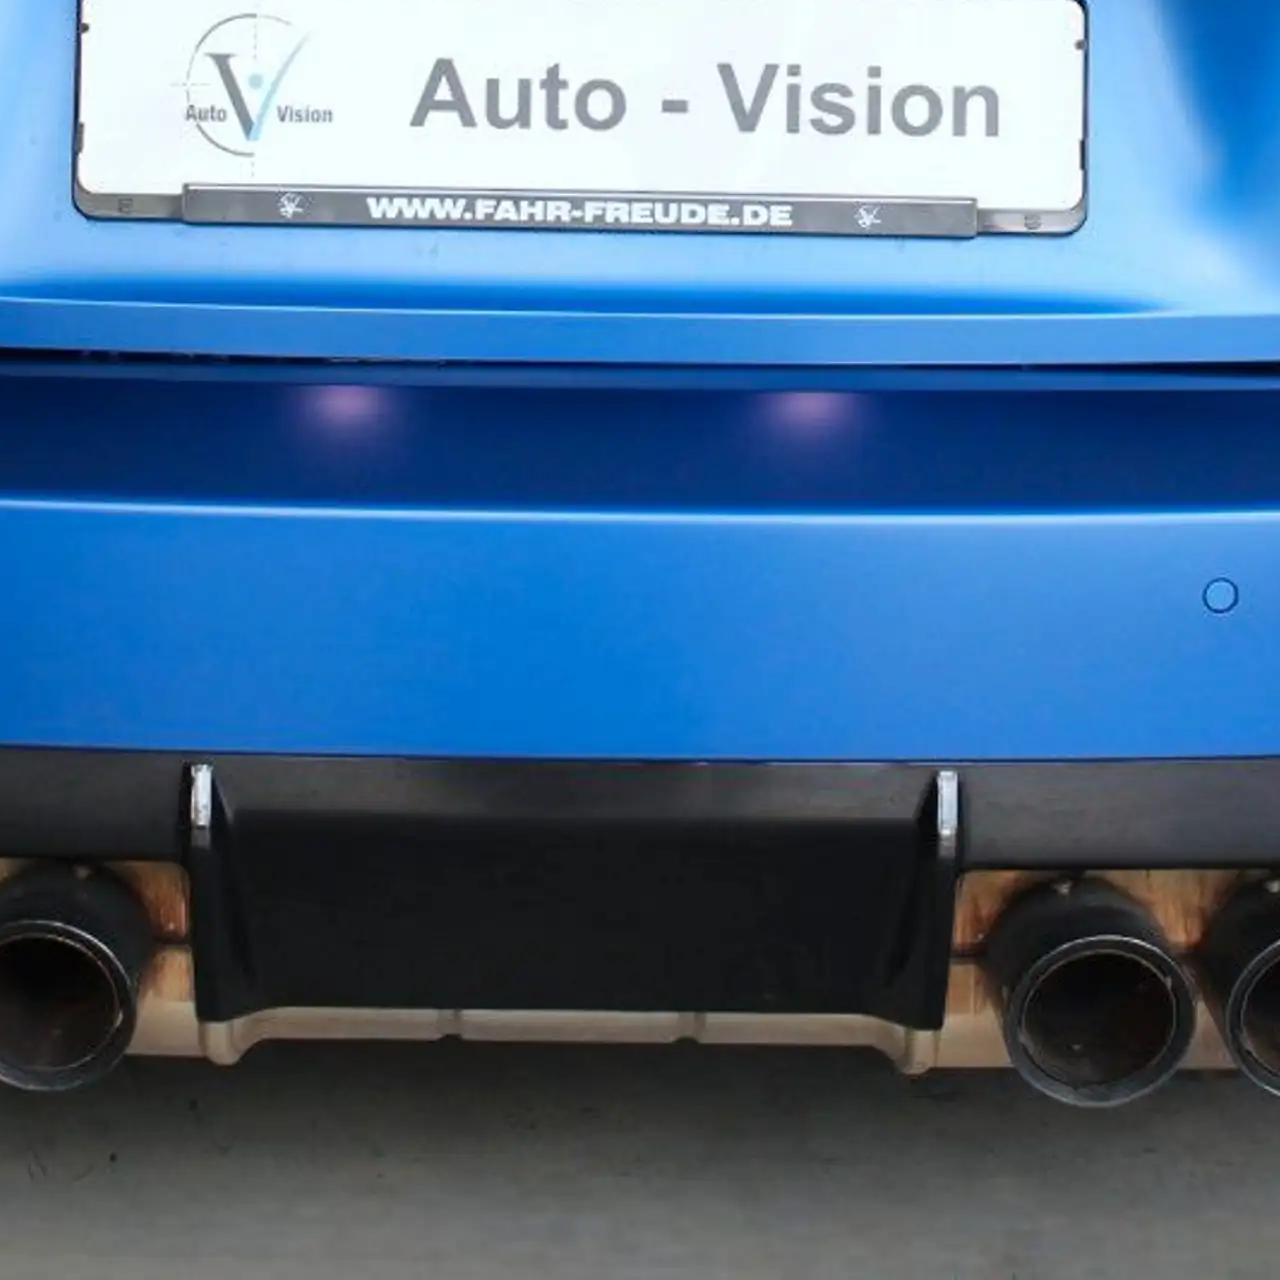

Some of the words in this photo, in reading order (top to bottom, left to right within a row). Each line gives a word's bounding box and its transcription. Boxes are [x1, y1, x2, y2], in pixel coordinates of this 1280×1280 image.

[410, 58, 626, 131] Auto
[717, 63, 1000, 136] Vision
[185, 104, 228, 122] Auto
[276, 105, 334, 123] Vision
[366, 196, 793, 227] WWW.FAHR-FREUDE.DE
